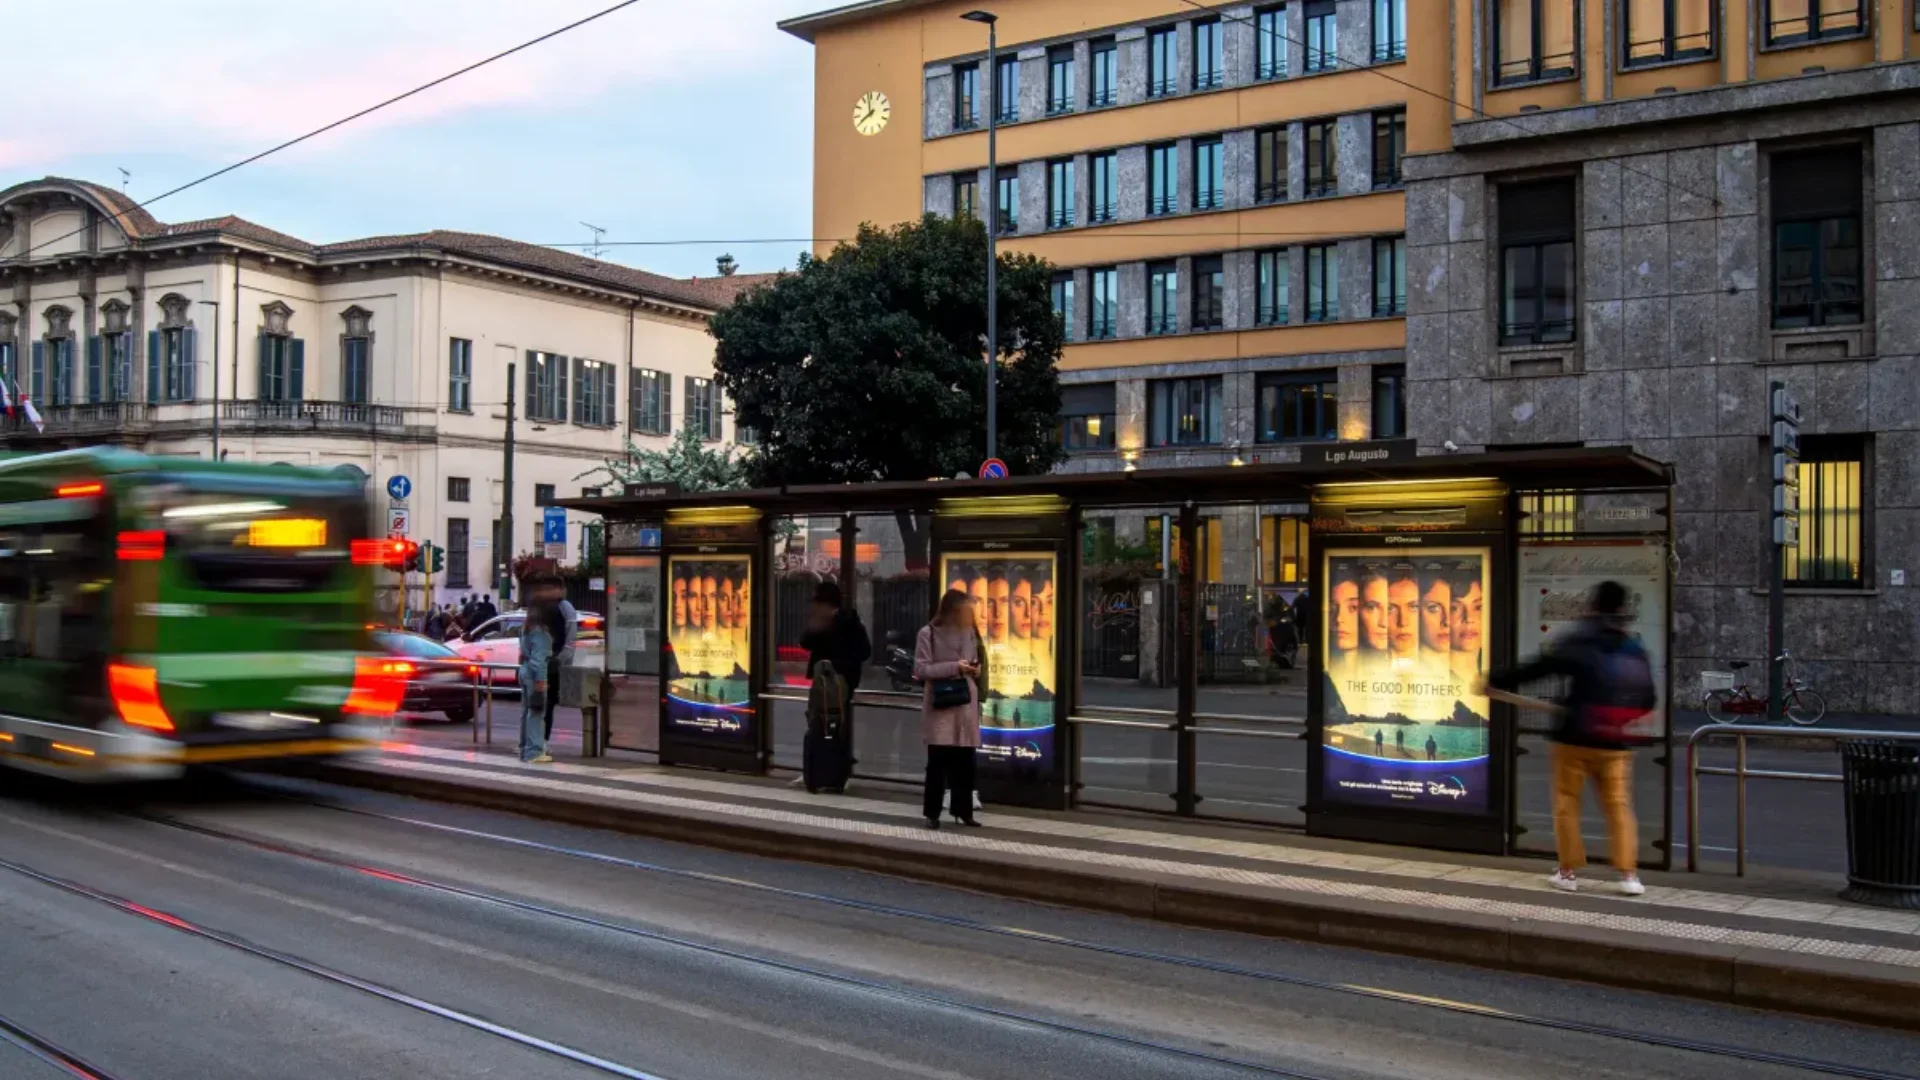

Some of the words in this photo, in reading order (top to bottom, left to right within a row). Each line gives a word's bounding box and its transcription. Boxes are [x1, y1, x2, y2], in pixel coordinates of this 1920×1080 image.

[1325, 450, 1346, 463] L.go
[1348, 448, 1389, 463] Augusto
[1346, 680, 1367, 692] THE
[1372, 682, 1402, 694] GOOD
[1407, 683, 1463, 697] MOTHERS
[1426, 776, 1468, 800] Disney+
